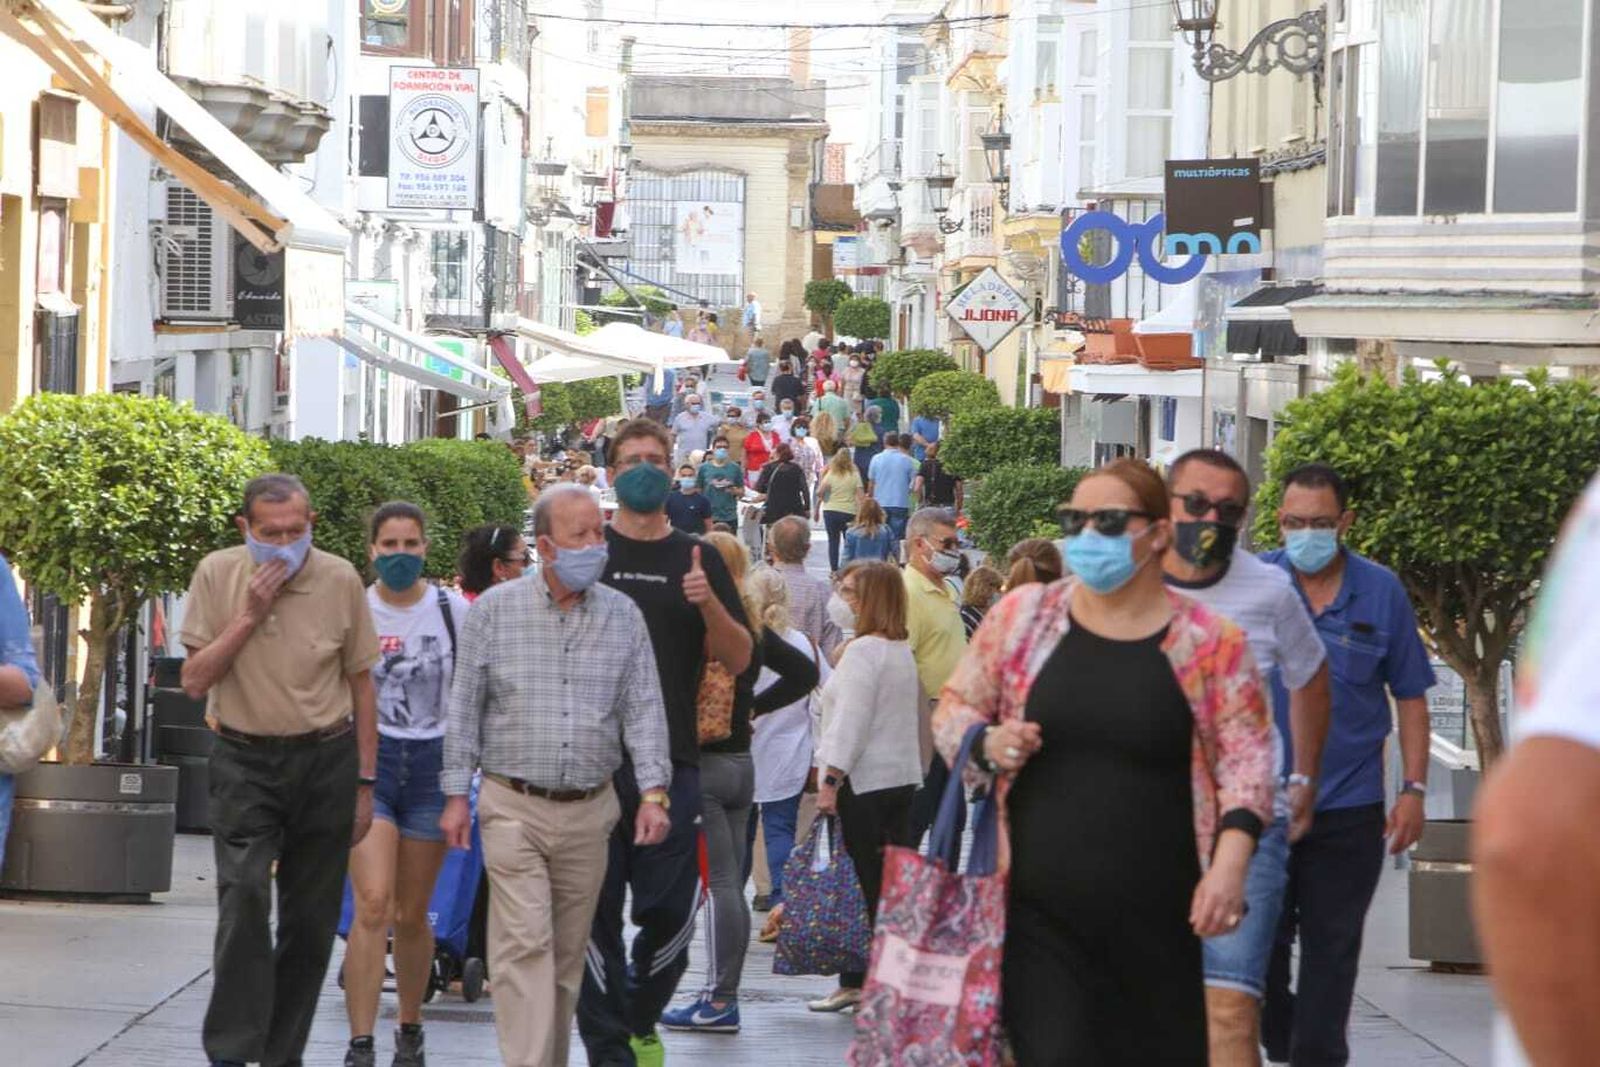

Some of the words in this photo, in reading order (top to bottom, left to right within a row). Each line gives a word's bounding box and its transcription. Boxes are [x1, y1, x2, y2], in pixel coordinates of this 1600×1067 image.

[408, 71, 446, 80] CENTRO
[449, 72, 462, 80] DE
[454, 83, 476, 93] VIAL
[958, 308, 1018, 322] JIJONA
